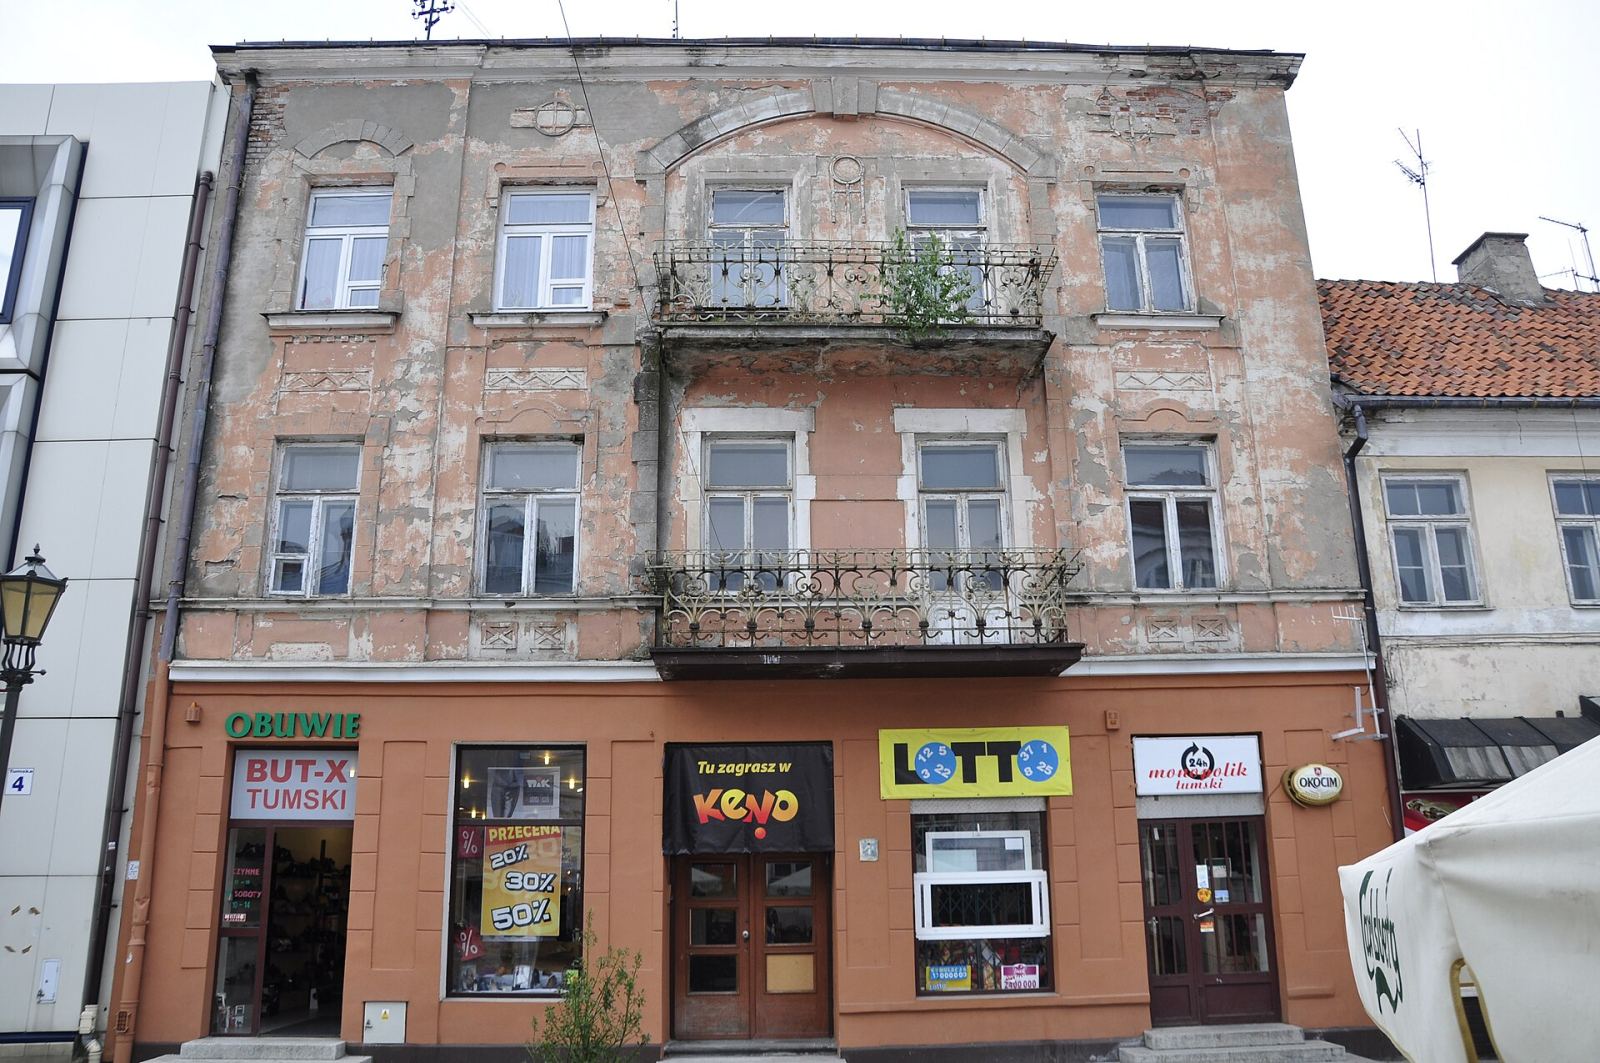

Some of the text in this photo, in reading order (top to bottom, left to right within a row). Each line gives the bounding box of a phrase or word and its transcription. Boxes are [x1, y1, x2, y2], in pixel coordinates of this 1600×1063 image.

[225, 712, 361, 738] OBUWIE
[918, 747, 934, 763] 12
[938, 745, 947, 756] 5
[1020, 745, 1034, 762] 37
[1041, 743, 1048, 753] 1
[697, 761, 792, 777] Tu zagrasz w
[933, 763, 951, 779] 22
[1036, 761, 1054, 775] 25
[1188, 758, 1208, 768] 24h
[246, 759, 349, 784] BUT-X
[921, 768, 931, 779] 3
[1024, 767, 1034, 777] 8
[1148, 762, 1248, 781] monopolik
[12, 776, 25, 791] 4
[1175, 778, 1223, 790] tumski
[1300, 777, 1338, 788] OKOCIM
[246, 789, 347, 810] TUMSKI
[489, 826, 560, 842] PRZECENA
[489, 844, 528, 869] 20%
[505, 872, 556, 892] 30%
[491, 898, 551, 931] 50%
